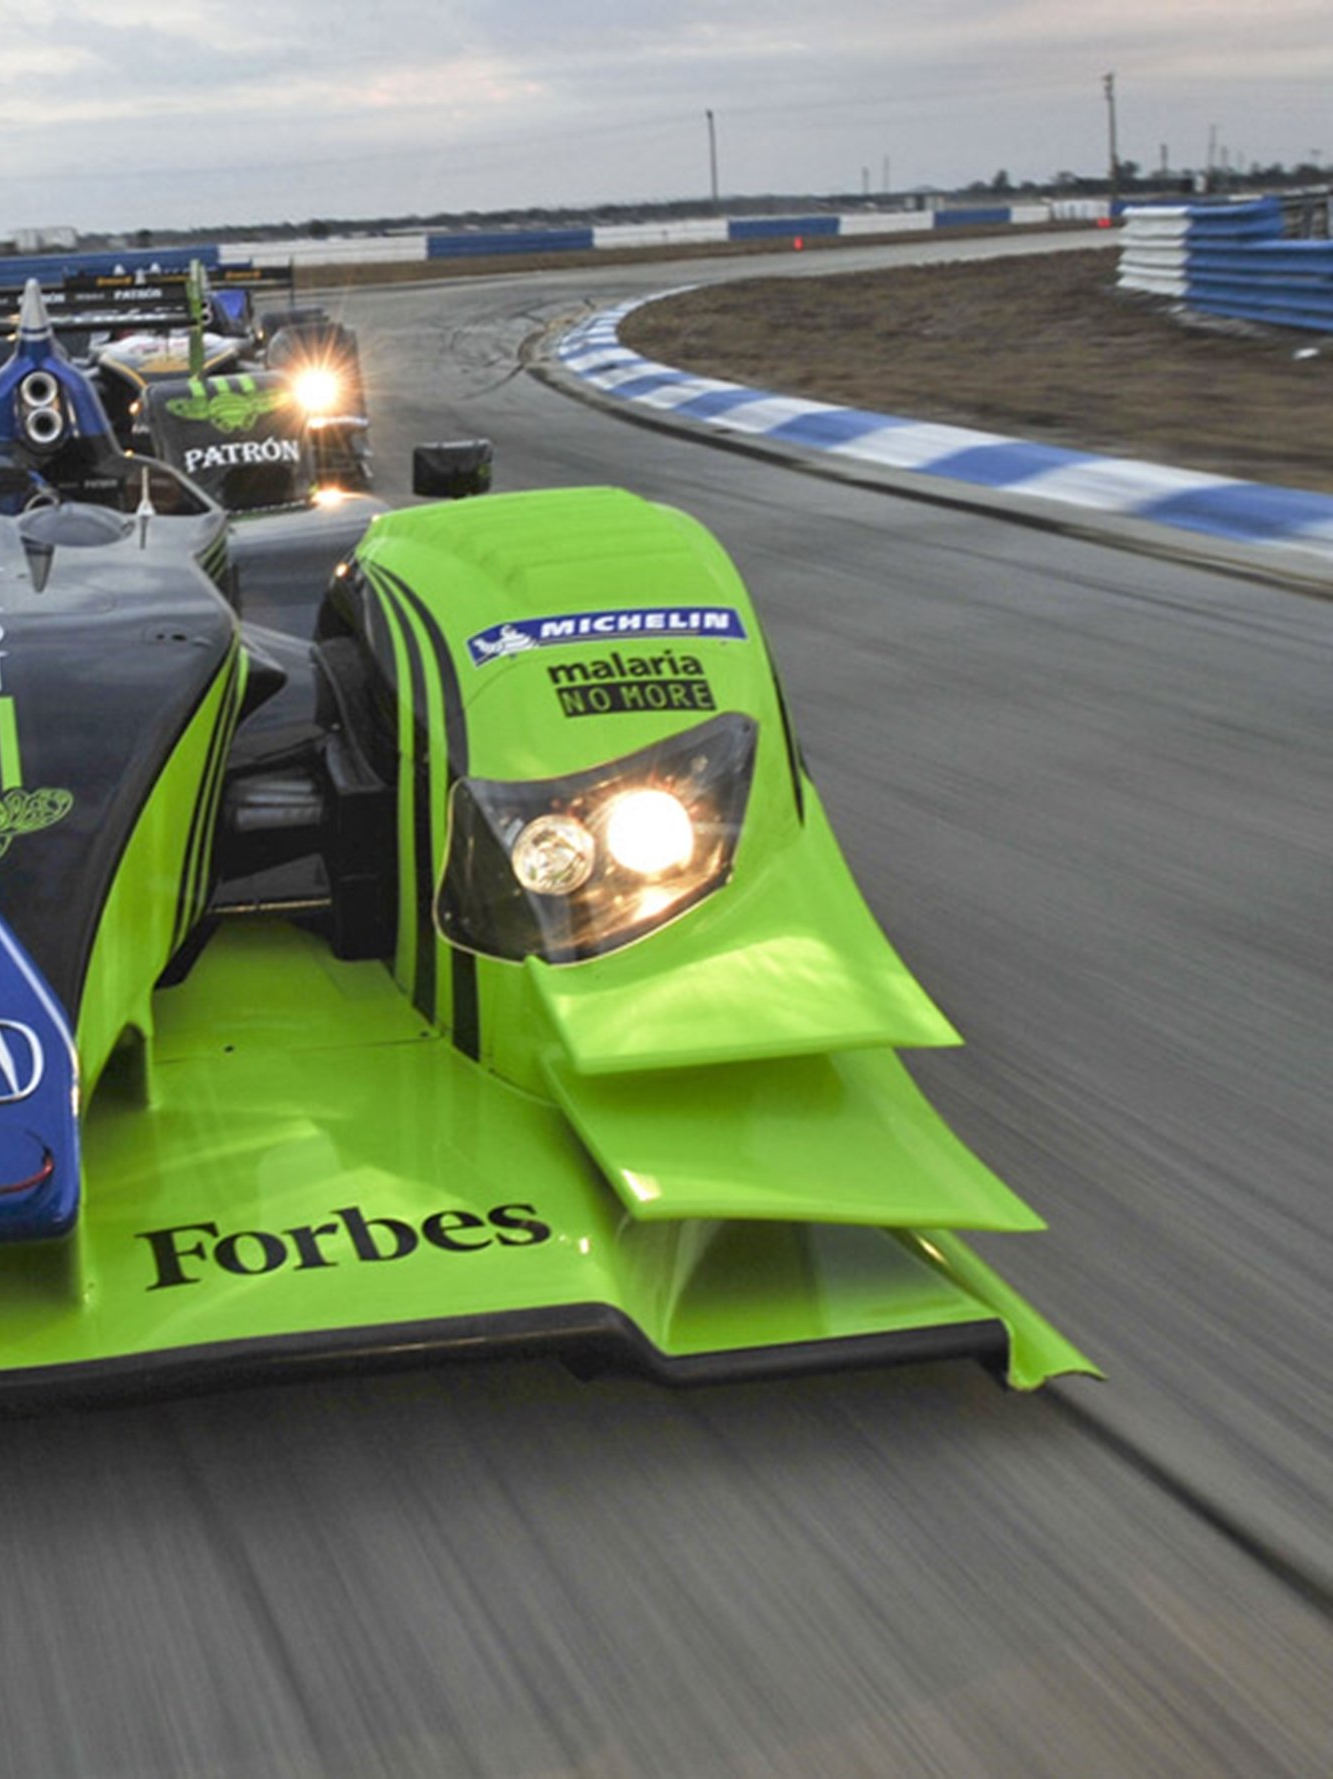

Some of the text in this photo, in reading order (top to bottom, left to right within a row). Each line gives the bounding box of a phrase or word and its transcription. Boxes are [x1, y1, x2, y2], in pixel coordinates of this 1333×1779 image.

[185, 436, 299, 474] PATRÓN
[539, 611, 731, 639] MICHELIN
[547, 650, 704, 684] malaria
[562, 684, 712, 714] NO MORE
[133, 1201, 554, 1292] Forbes
